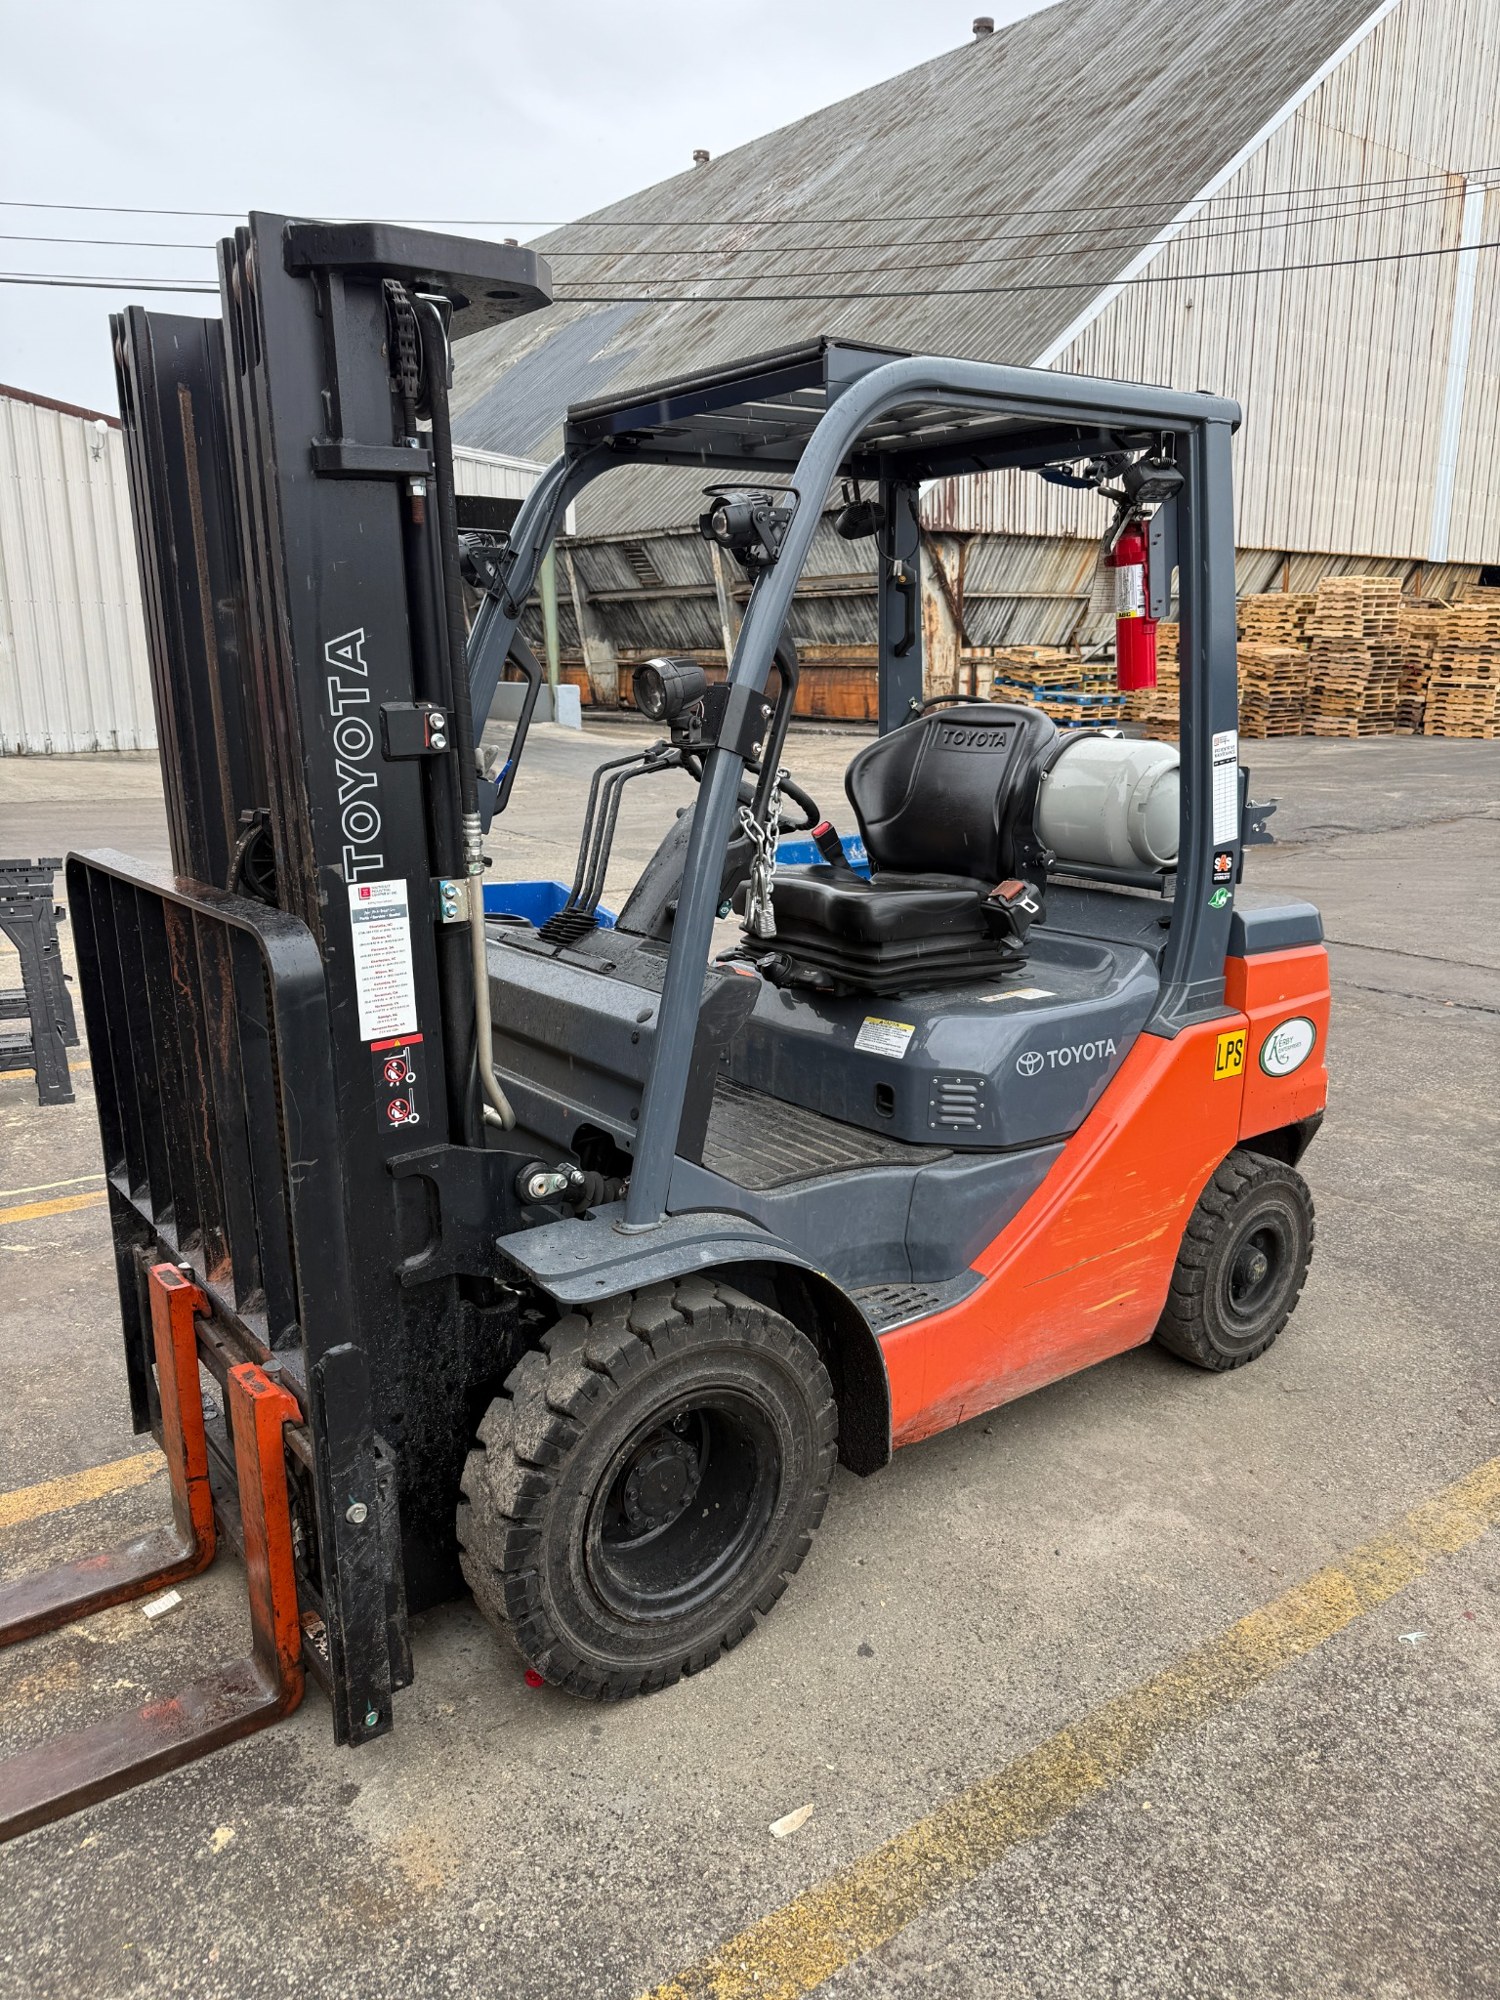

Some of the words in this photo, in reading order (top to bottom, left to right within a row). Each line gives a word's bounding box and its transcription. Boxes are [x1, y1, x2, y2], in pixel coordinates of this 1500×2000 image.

[943, 729, 1007, 747] TOYOTA
[325, 628, 383, 883] TOYOTA
[1214, 854, 1232, 872] SAS
[1046, 1038, 1117, 1068] TOYOTA
[1216, 1039, 1243, 1071] LPS
